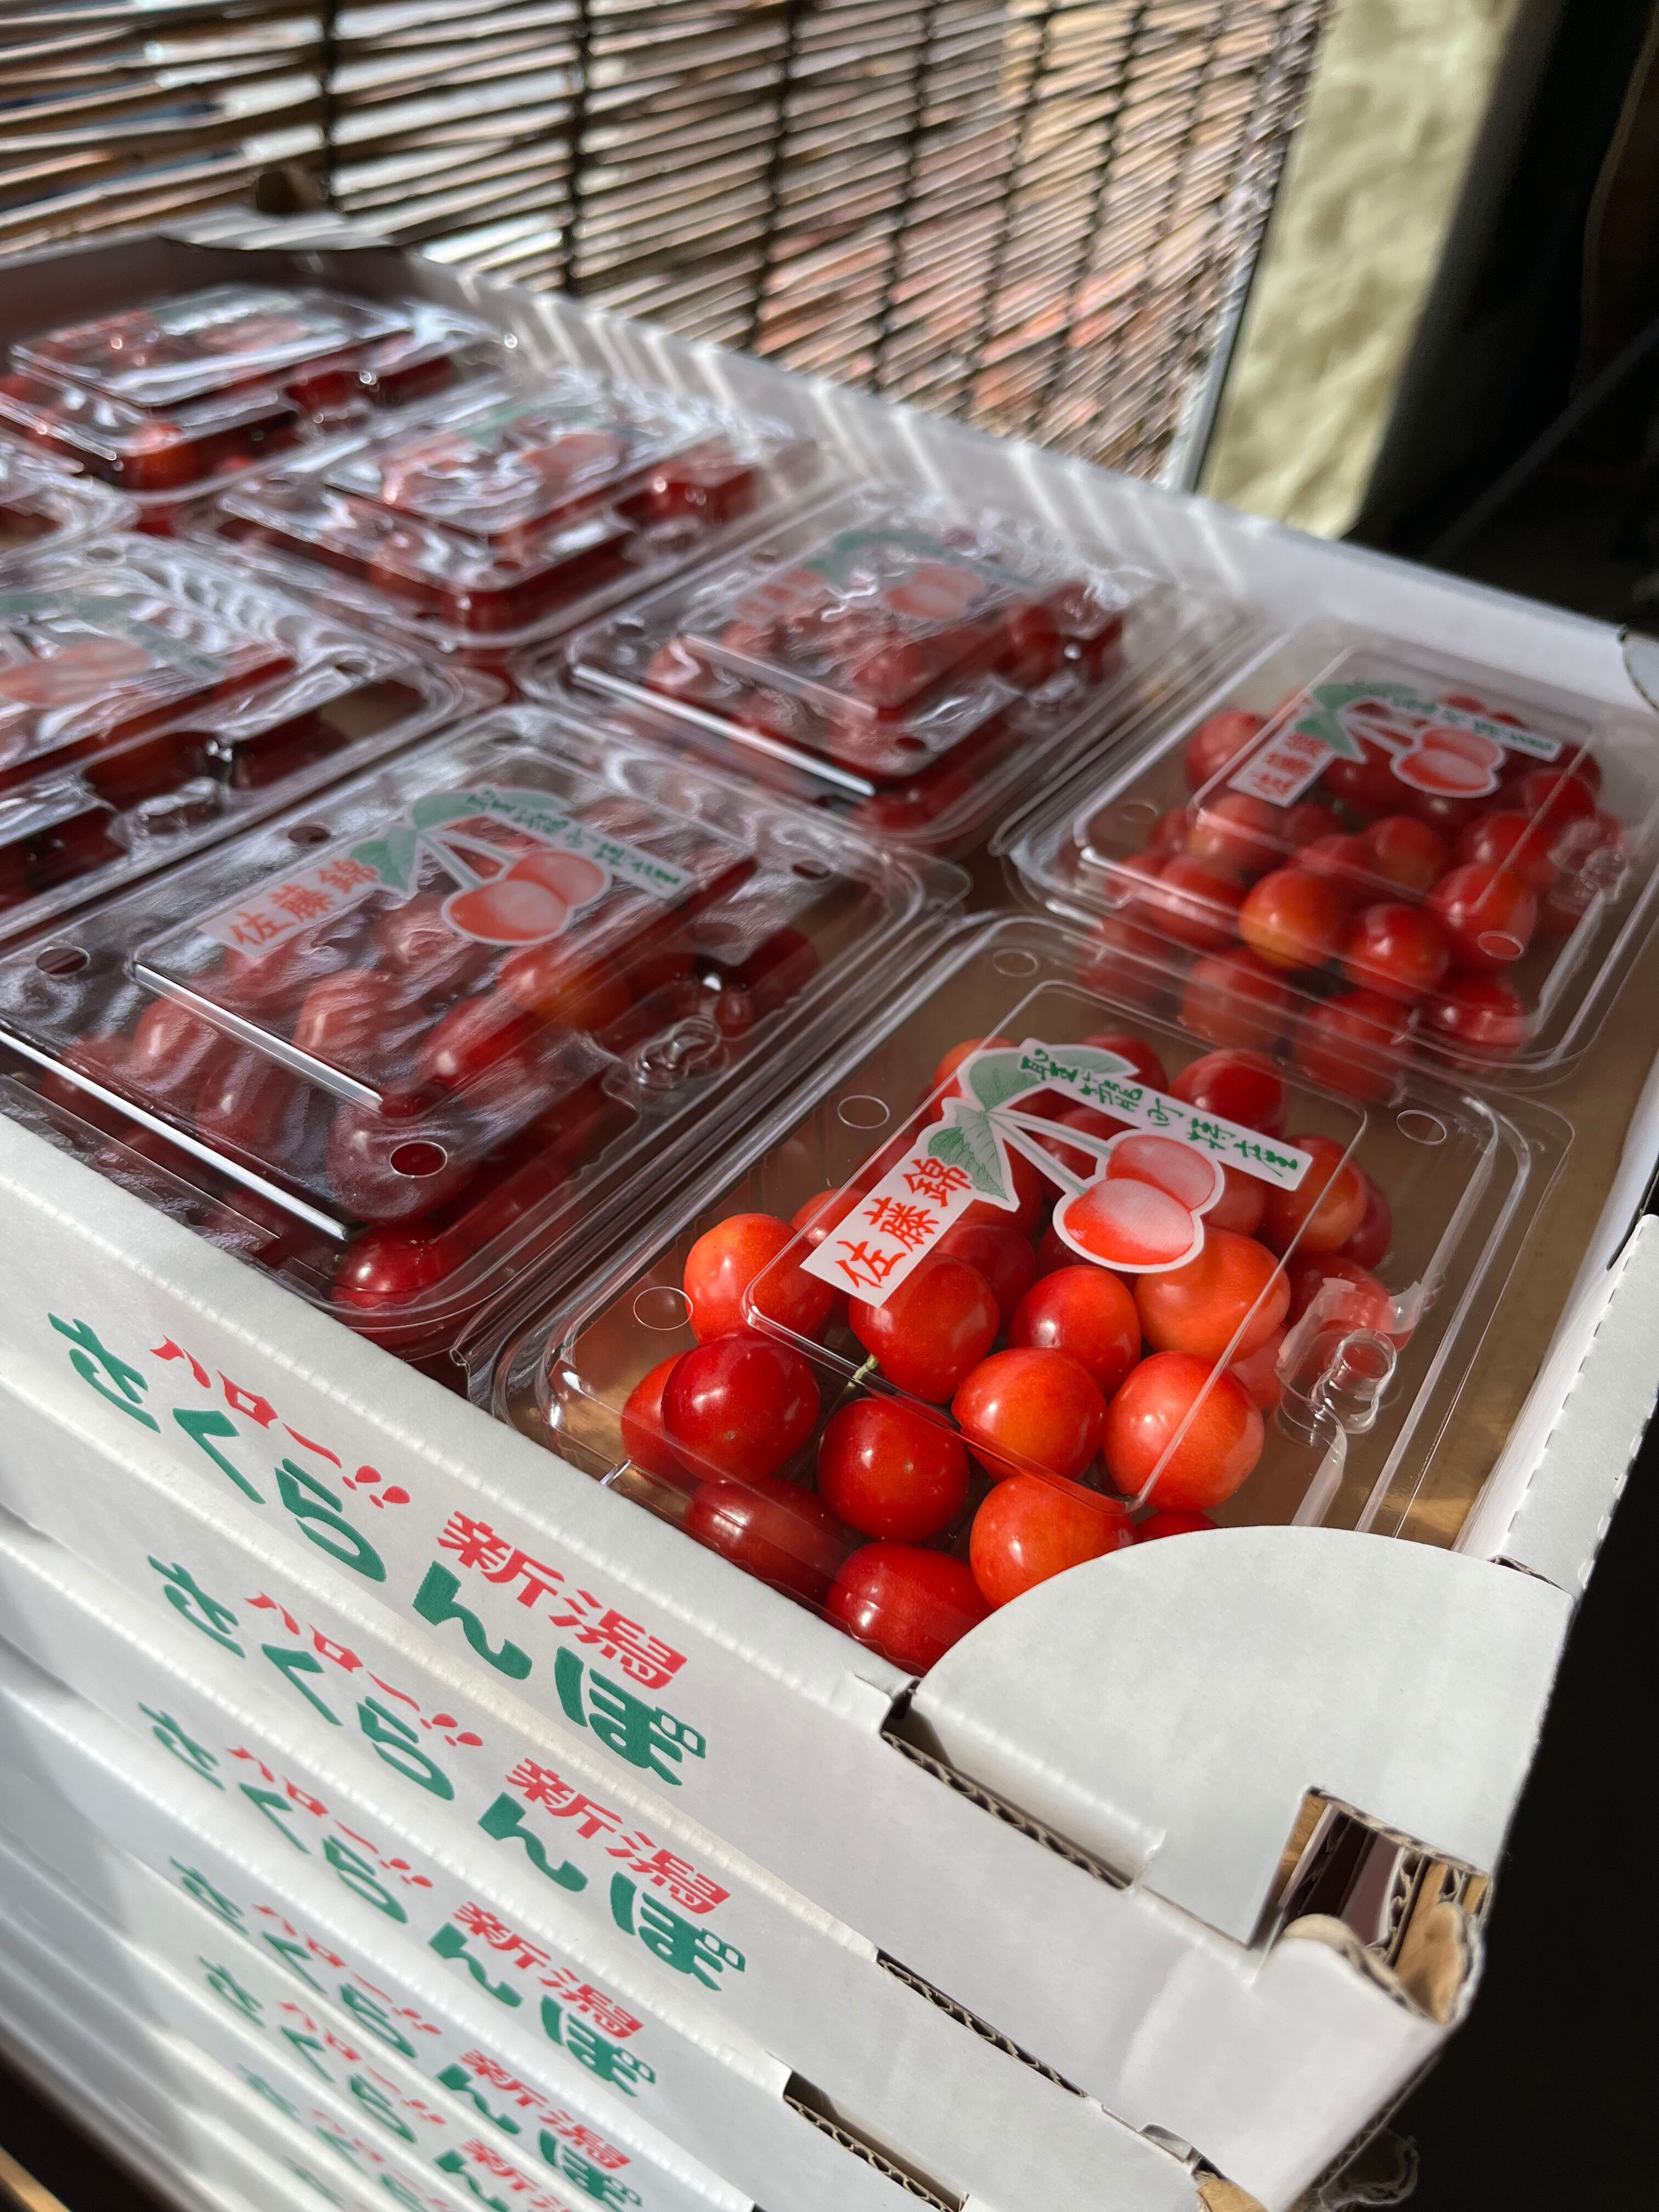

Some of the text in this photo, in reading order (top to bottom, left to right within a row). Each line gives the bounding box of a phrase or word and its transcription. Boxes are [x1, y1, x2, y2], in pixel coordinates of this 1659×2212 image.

[230, 859, 380, 947] 佐藤錦
[1019, 1047, 1299, 1177] 聖籠町特産
[834, 1156, 973, 1289] 佐藤錦
[47, 1312, 707, 1786] さくらんぼ
[437, 1510, 688, 1690] 新潟
[147, 1556, 746, 1991] さくらんぼ
[505, 1757, 731, 1915] 新潟
[138, 1702, 657, 2098] さくらんぼ
[453, 1901, 644, 2040] 新潟
[461, 2050, 632, 2171] 新潟
